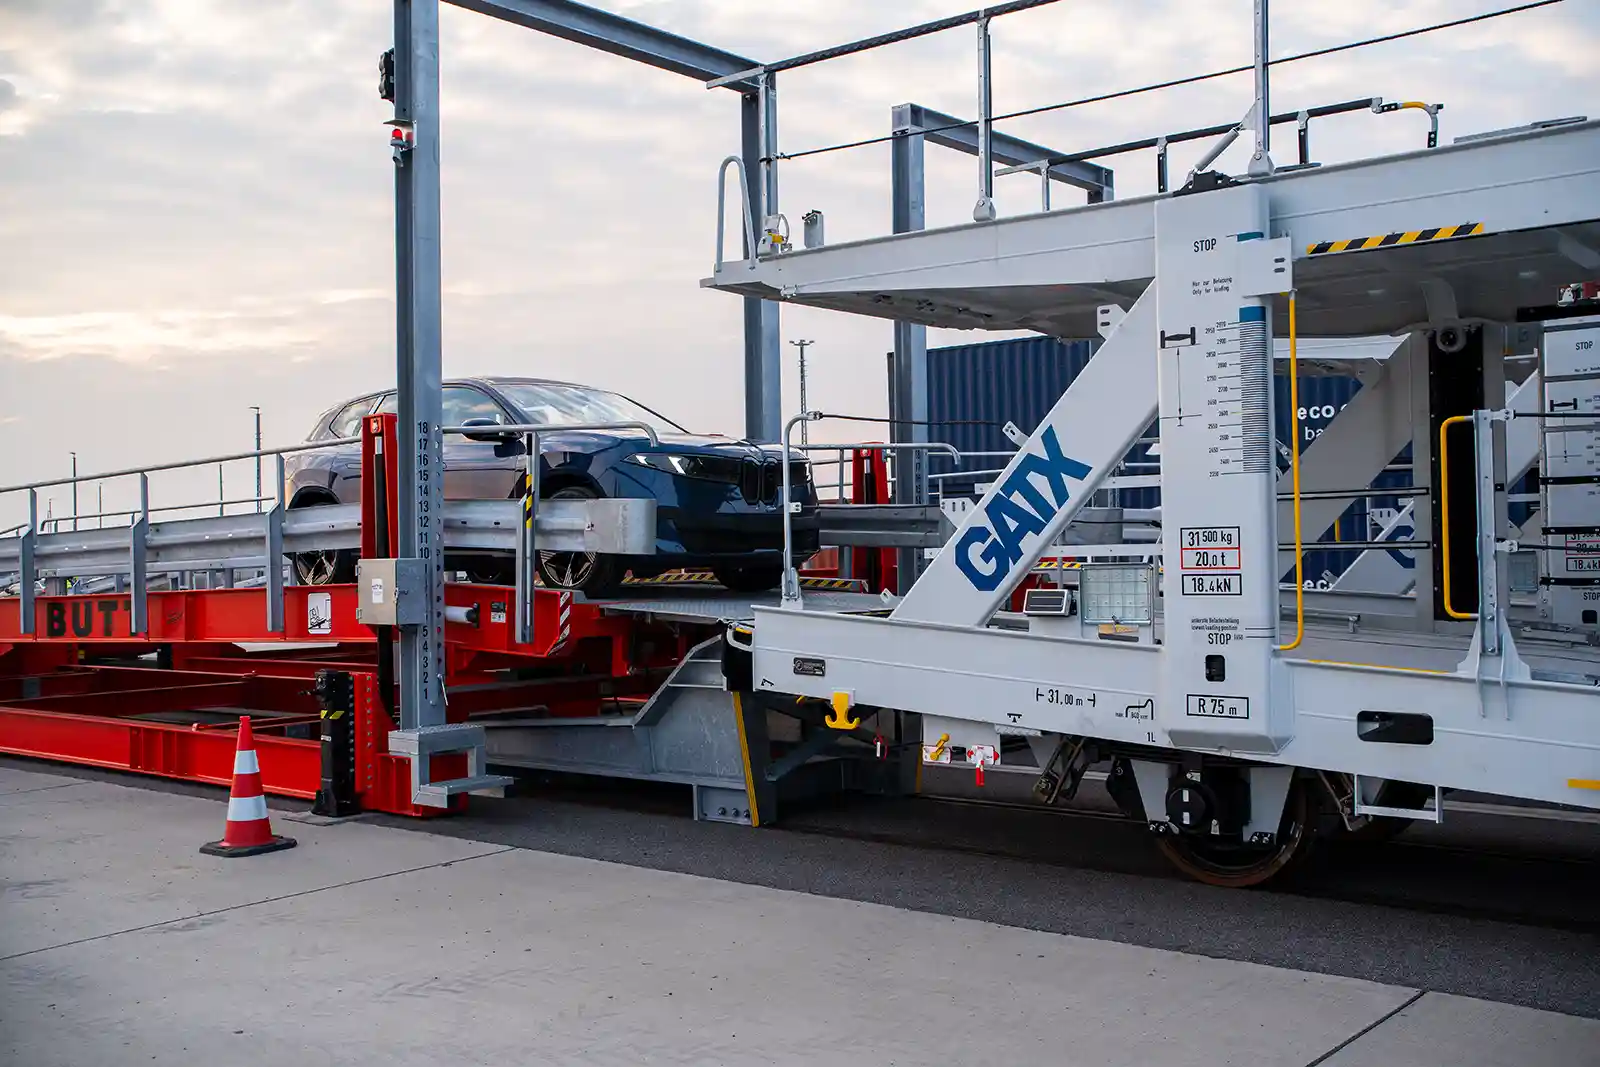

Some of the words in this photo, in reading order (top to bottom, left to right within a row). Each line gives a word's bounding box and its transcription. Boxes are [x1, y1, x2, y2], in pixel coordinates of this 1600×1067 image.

[1193, 238, 1217, 253] STOP
[1575, 340, 1594, 351] STOP
[1297, 405, 1335, 420] eco
[417, 421, 429, 434] 18
[418, 439, 429, 451] 17
[418, 454, 429, 466] 16
[418, 470, 429, 482] 15
[418, 485, 429, 497] 14
[418, 501, 429, 513] 13
[955, 424, 1093, 592] GATX
[418, 516, 429, 528] 12
[418, 532, 429, 544] 11
[1188, 531, 1199, 547] 31
[1202, 530, 1218, 542] 500
[1221, 530, 1232, 545] kg
[419, 547, 430, 559] 10
[1221, 552, 1226, 566] t
[422, 626, 428, 637] 5
[1208, 633, 1231, 645] STOP
[422, 641, 428, 652] 4
[422, 656, 428, 668] 3
[422, 672, 428, 683] 2
[423, 688, 428, 699] 1
[1076, 698, 1083, 706] m
[1198, 698, 1206, 713] R
[1211, 699, 1224, 714] 75
[1229, 706, 1237, 715] m
[1147, 732, 1156, 742] 1L
